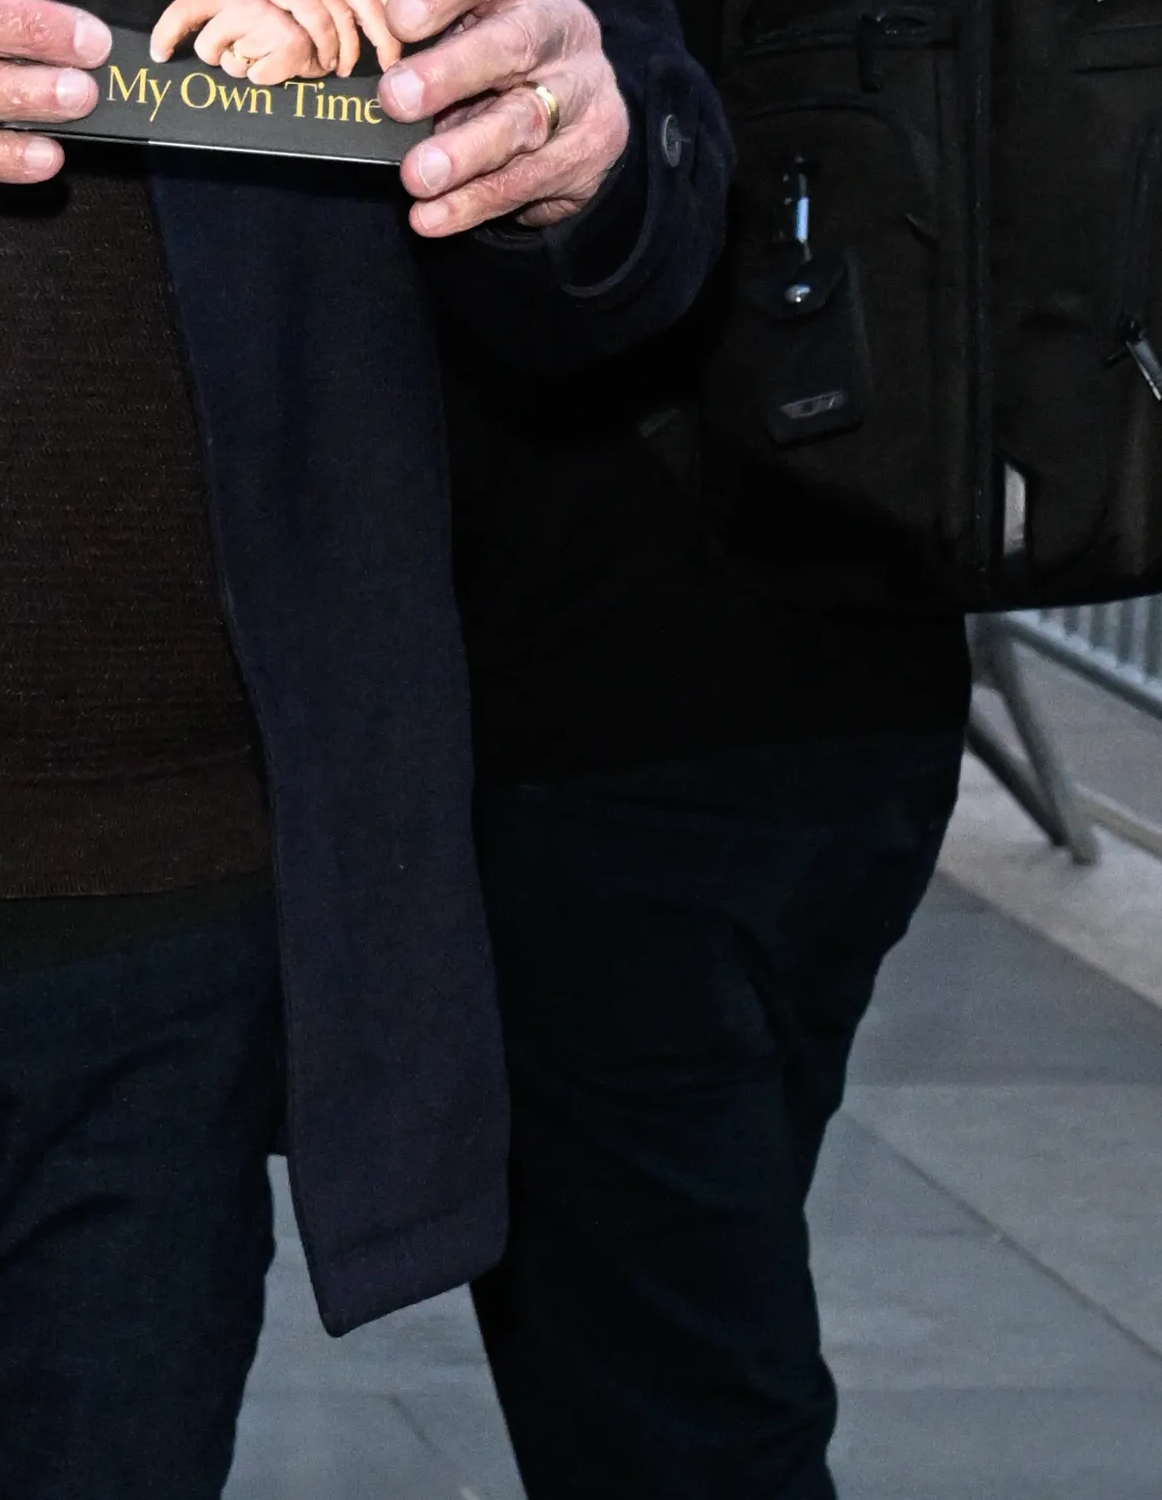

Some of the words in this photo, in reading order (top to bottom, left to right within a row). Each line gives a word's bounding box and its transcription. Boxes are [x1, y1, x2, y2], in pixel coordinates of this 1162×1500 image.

[106, 65, 171, 121] My
[180, 72, 273, 115] Own
[284, 80, 383, 125] Time
